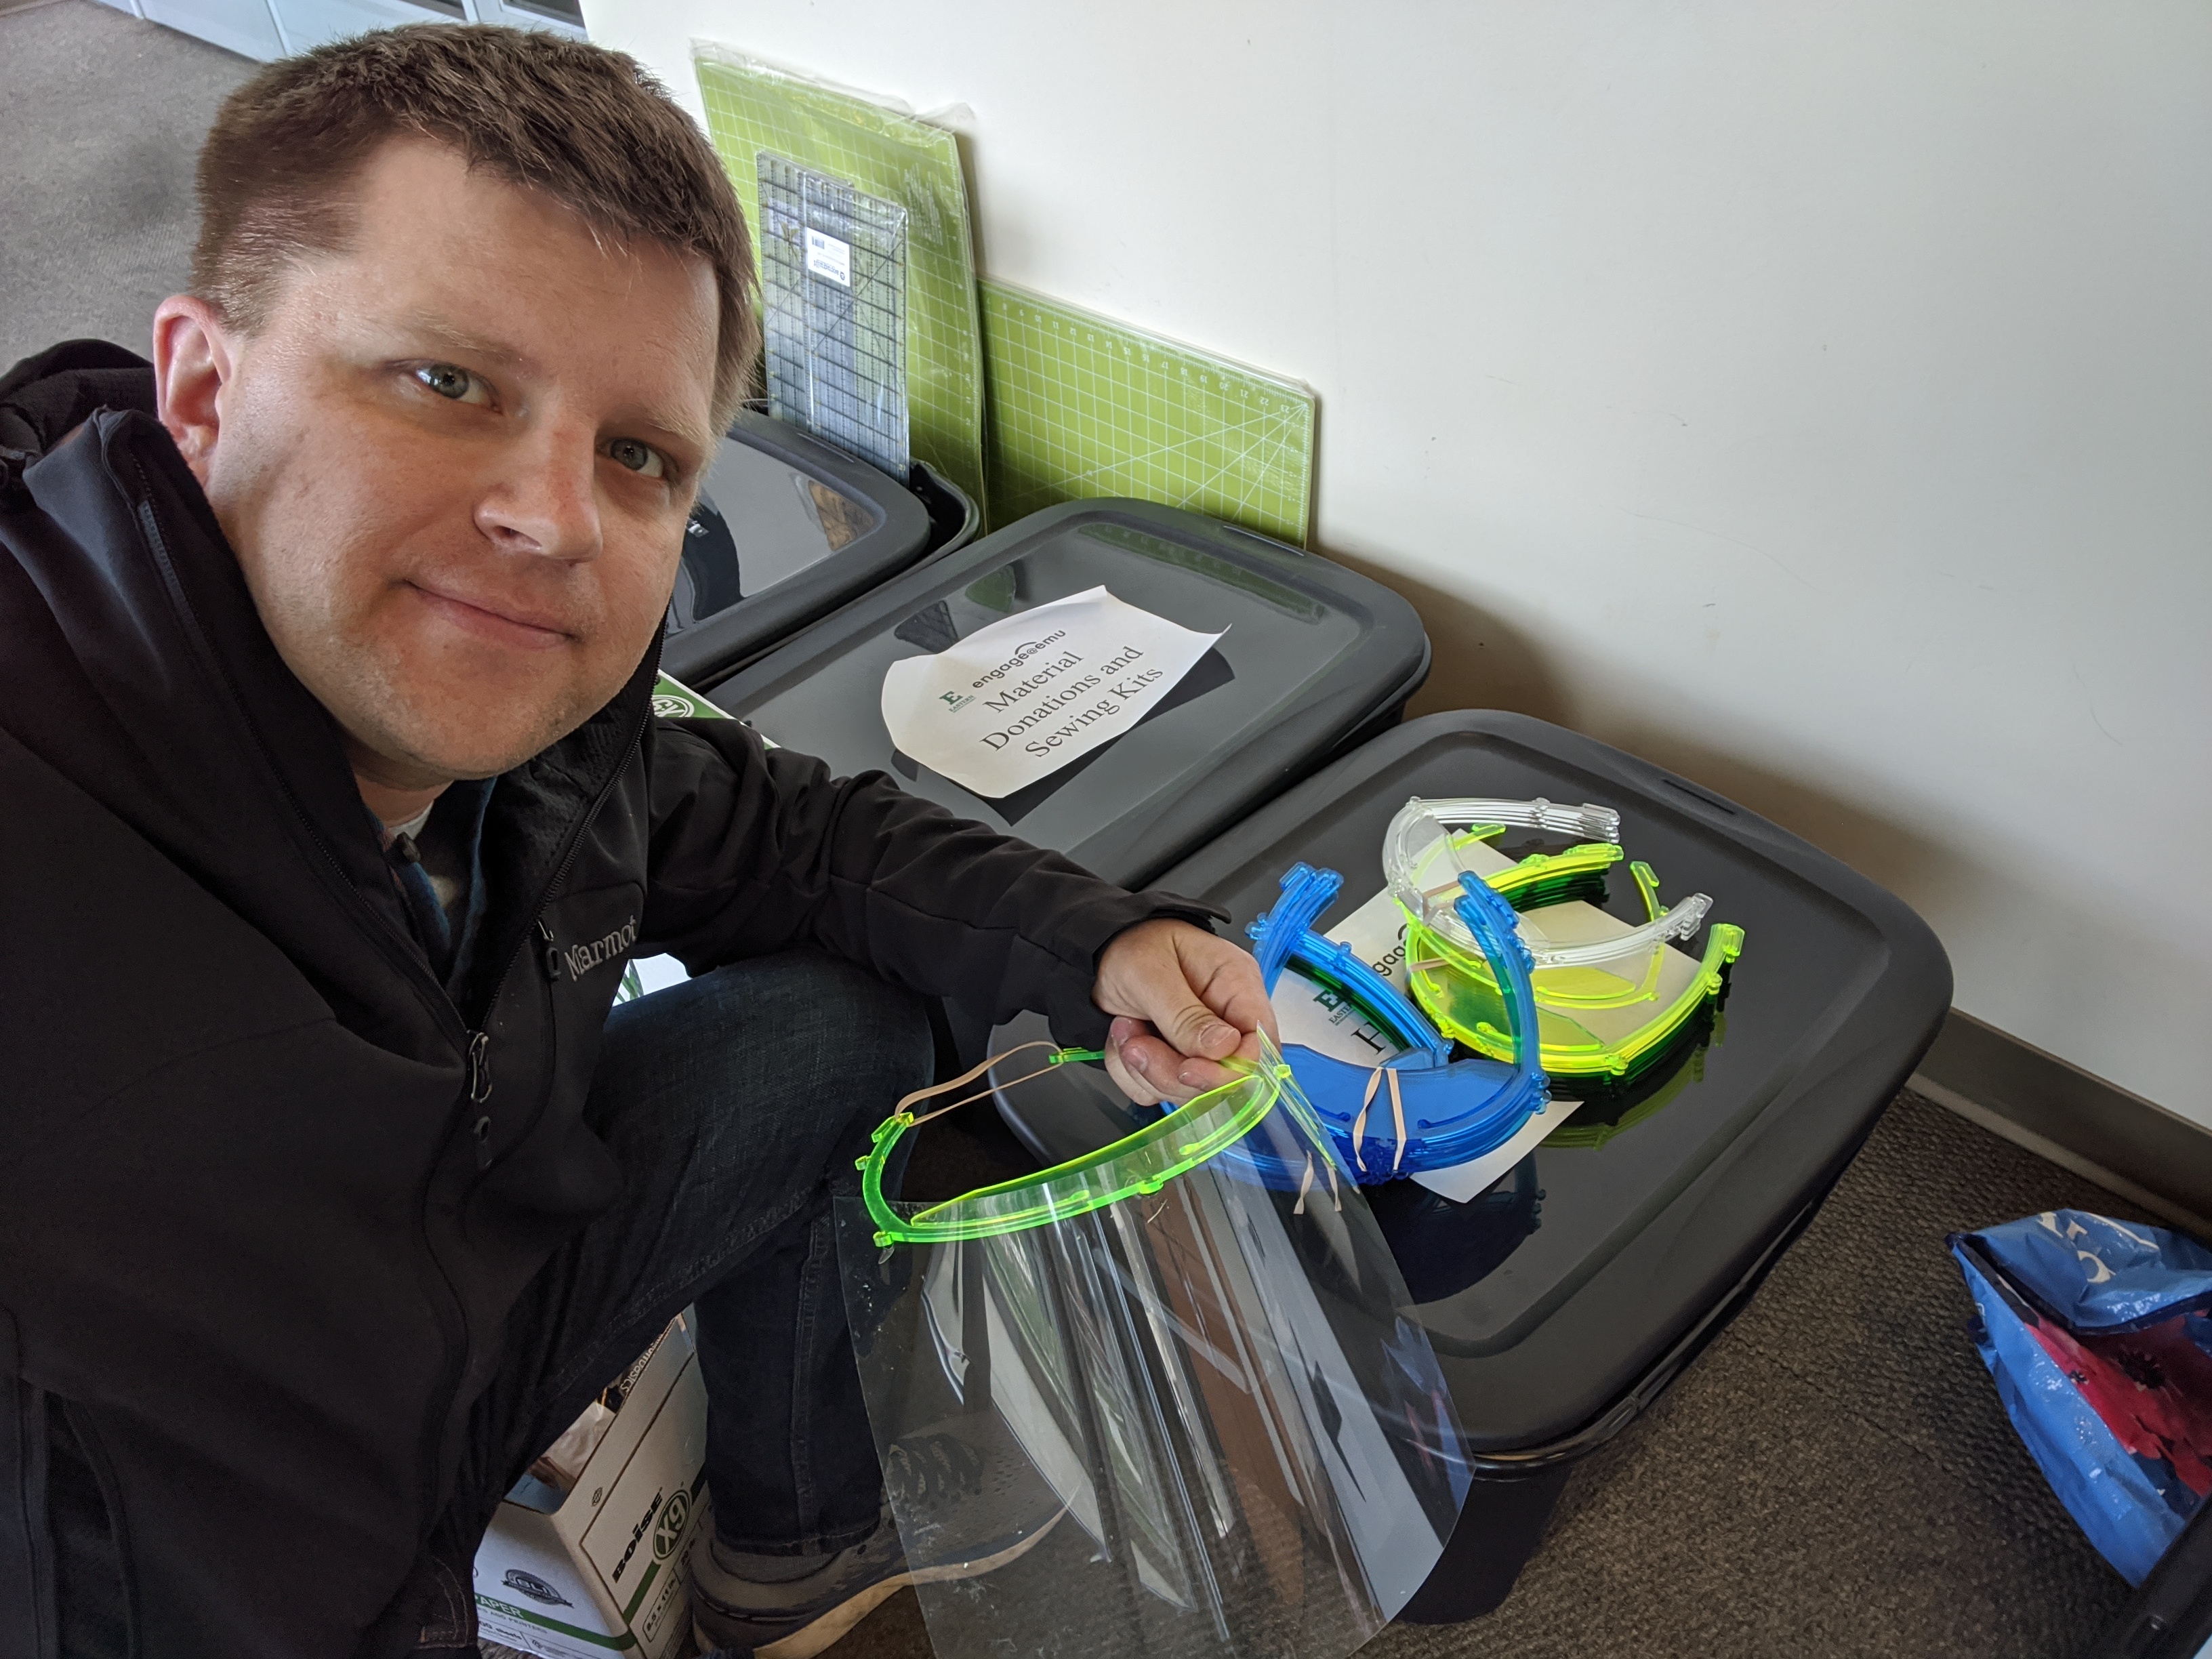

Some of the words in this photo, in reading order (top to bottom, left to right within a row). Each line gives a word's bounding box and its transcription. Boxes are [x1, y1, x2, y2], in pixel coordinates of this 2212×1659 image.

[1052, 321, 1059, 329] 11
[1161, 361, 1169, 370] 17
[1200, 374, 1208, 384] 19
[1219, 381, 1229, 391] 20
[1240, 389, 1249, 398] 21
[1260, 396, 1269, 406] 22
[1280, 404, 1290, 414] 23
[972, 630, 1066, 689] engage@emu
[982, 651, 1084, 714] Material
[939, 691, 964, 705] E
[949, 695, 975, 712] EASTERN
[979, 674, 1101, 752] Donations
[1100, 646, 1145, 675] and
[1025, 699, 1120, 758] Sewing
[1107, 669, 1164, 701] Kits
[564, 914, 637, 982] Marmot
